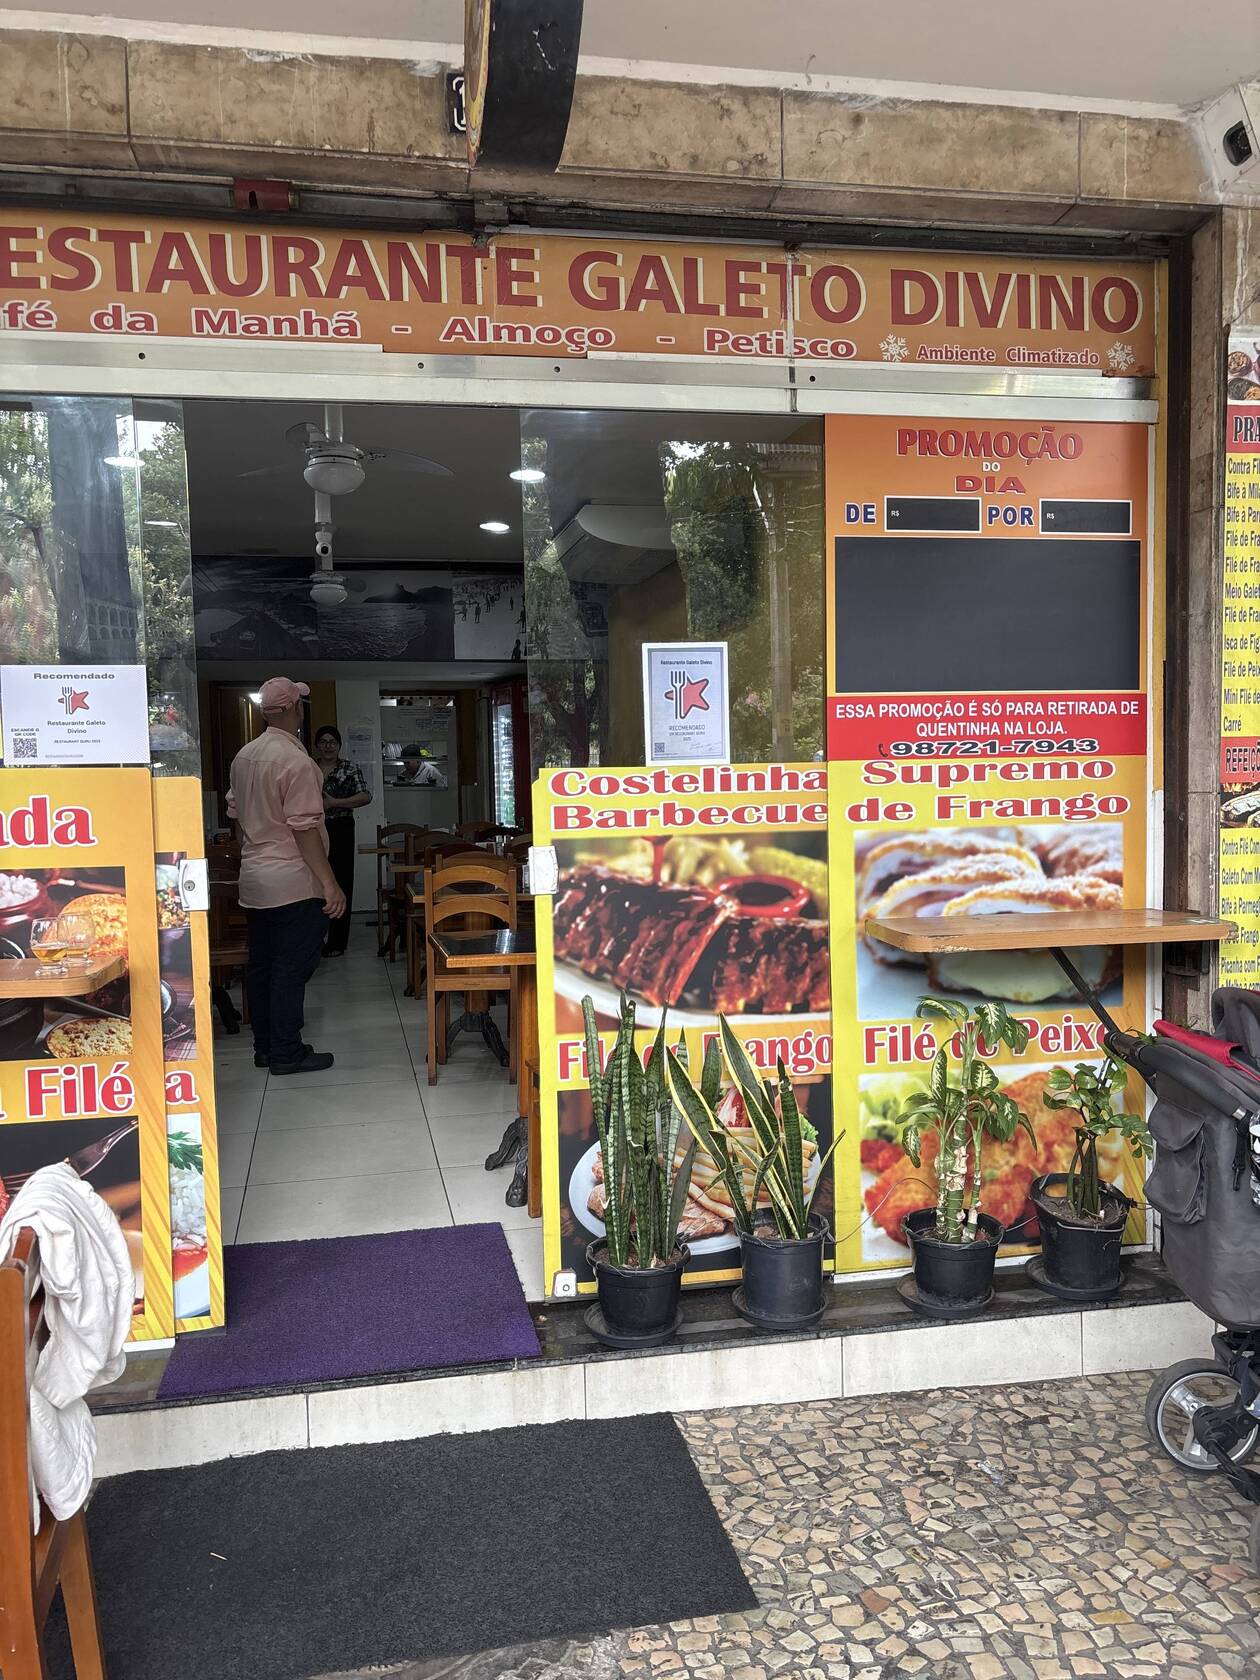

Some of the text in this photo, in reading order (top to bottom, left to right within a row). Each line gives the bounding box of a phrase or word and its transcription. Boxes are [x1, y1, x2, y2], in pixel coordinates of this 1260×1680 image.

[568, 251, 866, 324] GALETO
[890, 268, 1142, 333] DIVINO
[92, 304, 157, 333] da
[192, 307, 360, 338] Manhã
[440, 316, 615, 351] Almoço
[704, 326, 857, 360] Petisco
[916, 344, 1100, 365] Ambiente Climatizado
[897, 426, 1084, 465] PROMOÇÃO
[982, 461, 1000, 472] DO
[1227, 457, 1250, 474] Contra
[955, 475, 1026, 494] DIA
[1226, 482, 1240, 499] Bife
[1242, 482, 1246, 499] à
[845, 502, 1055, 527] DE R$ POR R$
[1226, 506, 1239, 523] Bife
[1241, 506, 1246, 523] à
[1226, 530, 1238, 547] Filé
[1240, 530, 1248, 547] de
[1225, 556, 1237, 573] Filé
[1240, 557, 1248, 573] de
[1225, 582, 1241, 599] Meio
[1225, 605, 1236, 622] Filé
[1239, 606, 1247, 622] de
[1224, 634, 1238, 650] Isca
[1240, 634, 1248, 650] de
[1224, 660, 1236, 677] Filé
[1238, 661, 1246, 677] de
[1224, 688, 1238, 704] Mini
[1240, 687, 1251, 704] Filé
[836, 699, 1139, 720] ESSA PROMOÇÃO É SÓ PARA RETIRADA DE
[916, 721, 1068, 737] QUENTINHA NA LOJA.
[1223, 714, 1241, 732] Carré
[890, 738, 1099, 757] 98721-7943
[550, 765, 827, 797] Costelinha
[862, 759, 1115, 789] Supremo
[552, 801, 827, 831] Barbecue
[846, 791, 1130, 823] de Frango
[1221, 837, 1238, 855] Contra
[1240, 836, 1249, 854] Filé
[1222, 868, 1239, 885] Galeto
[1241, 867, 1253, 884] Com
[1222, 897, 1232, 915] Bife
[1241, 926, 1259, 947] Frango
[1221, 956, 1242, 973] Picanha
[1244, 960, 1256, 973] com
[862, 1022, 937, 1065] Filé
[25, 1061, 135, 1118] Filé
